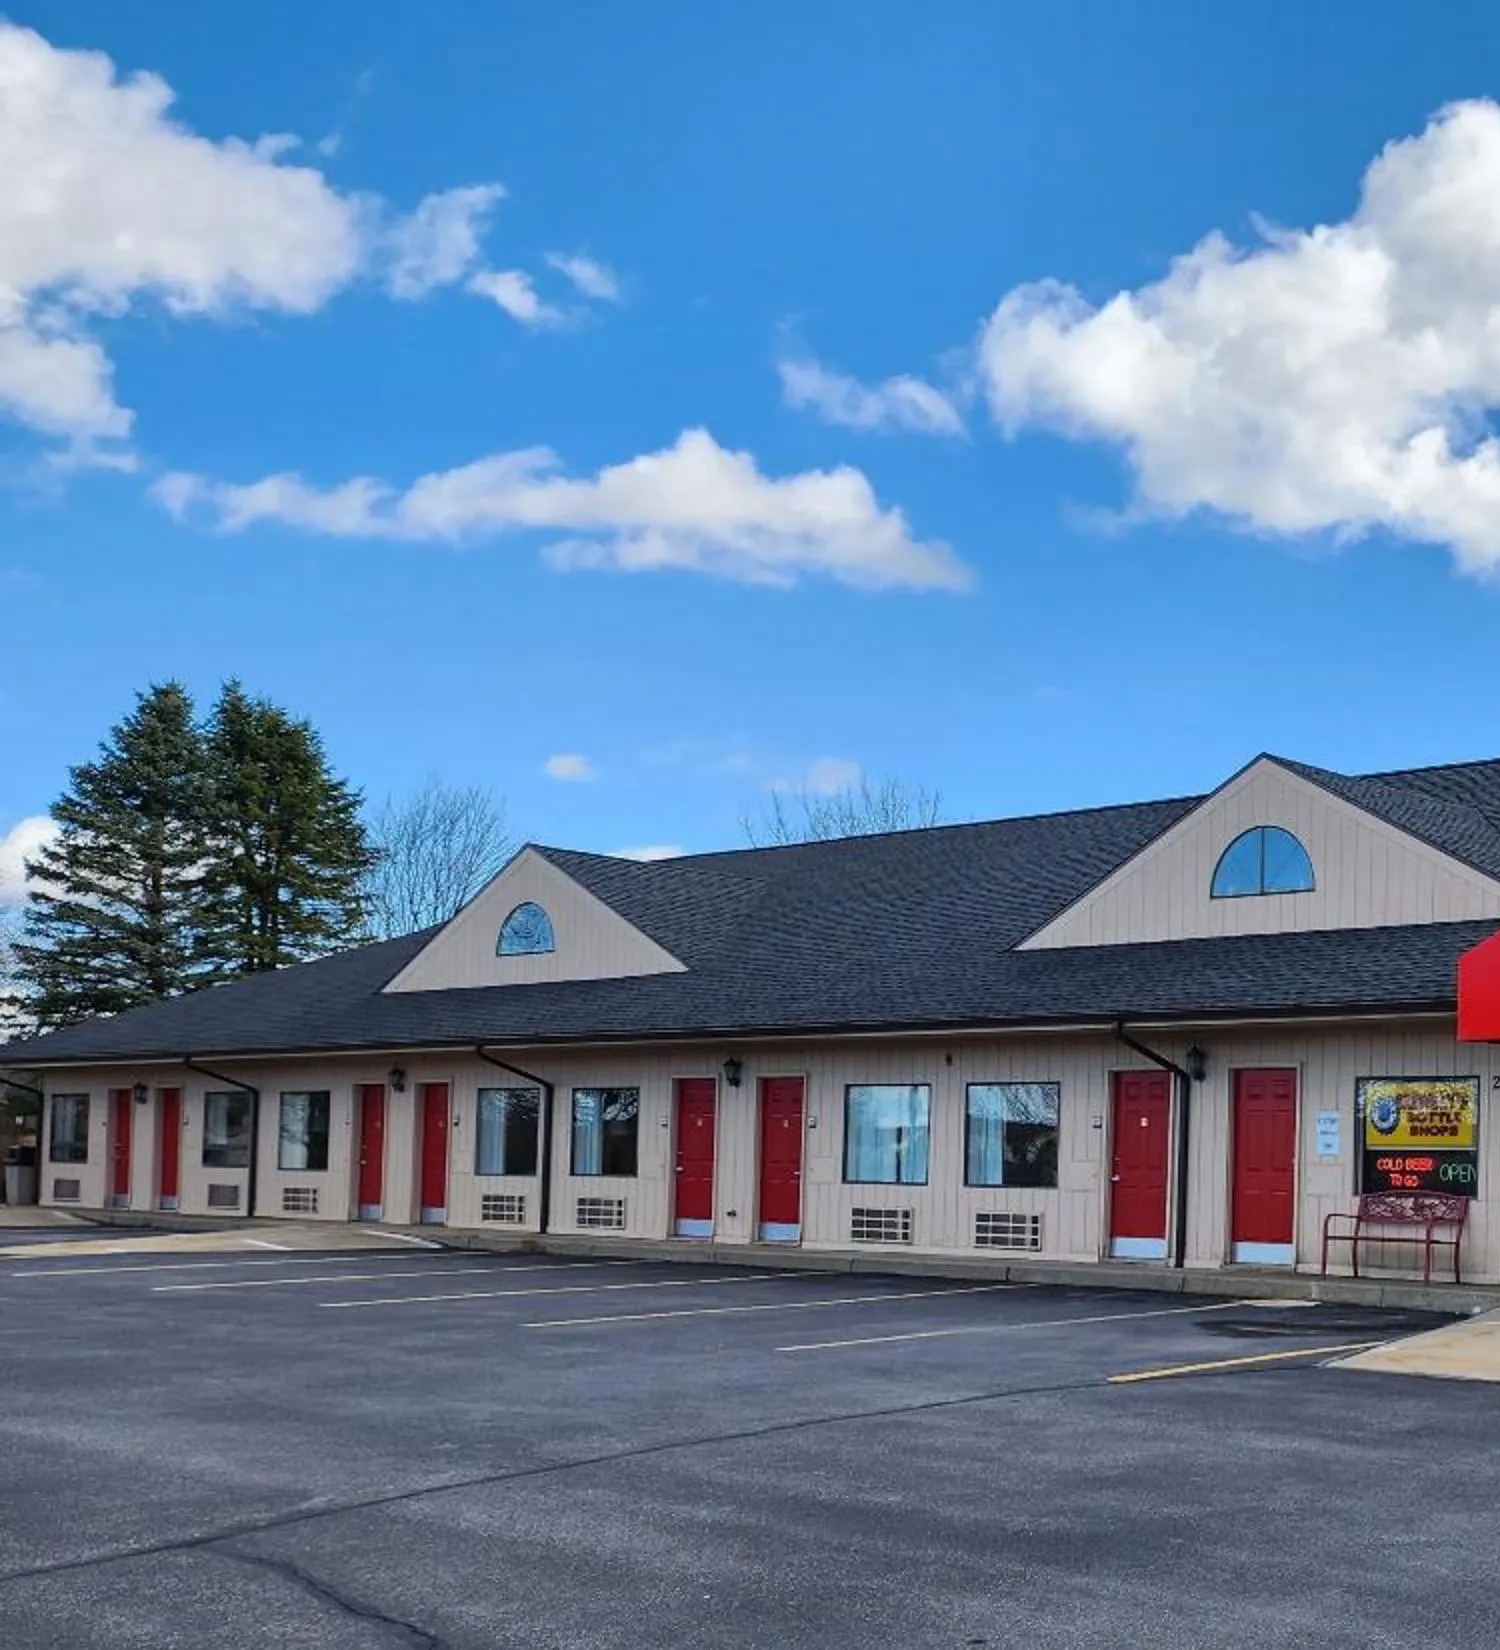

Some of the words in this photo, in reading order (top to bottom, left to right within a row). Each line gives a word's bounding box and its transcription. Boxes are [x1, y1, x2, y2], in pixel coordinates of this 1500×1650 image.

[1377, 1157, 1403, 1171] COLD
[1390, 1173, 1403, 1186] TO
[1440, 1163, 1477, 1183] OPEN
